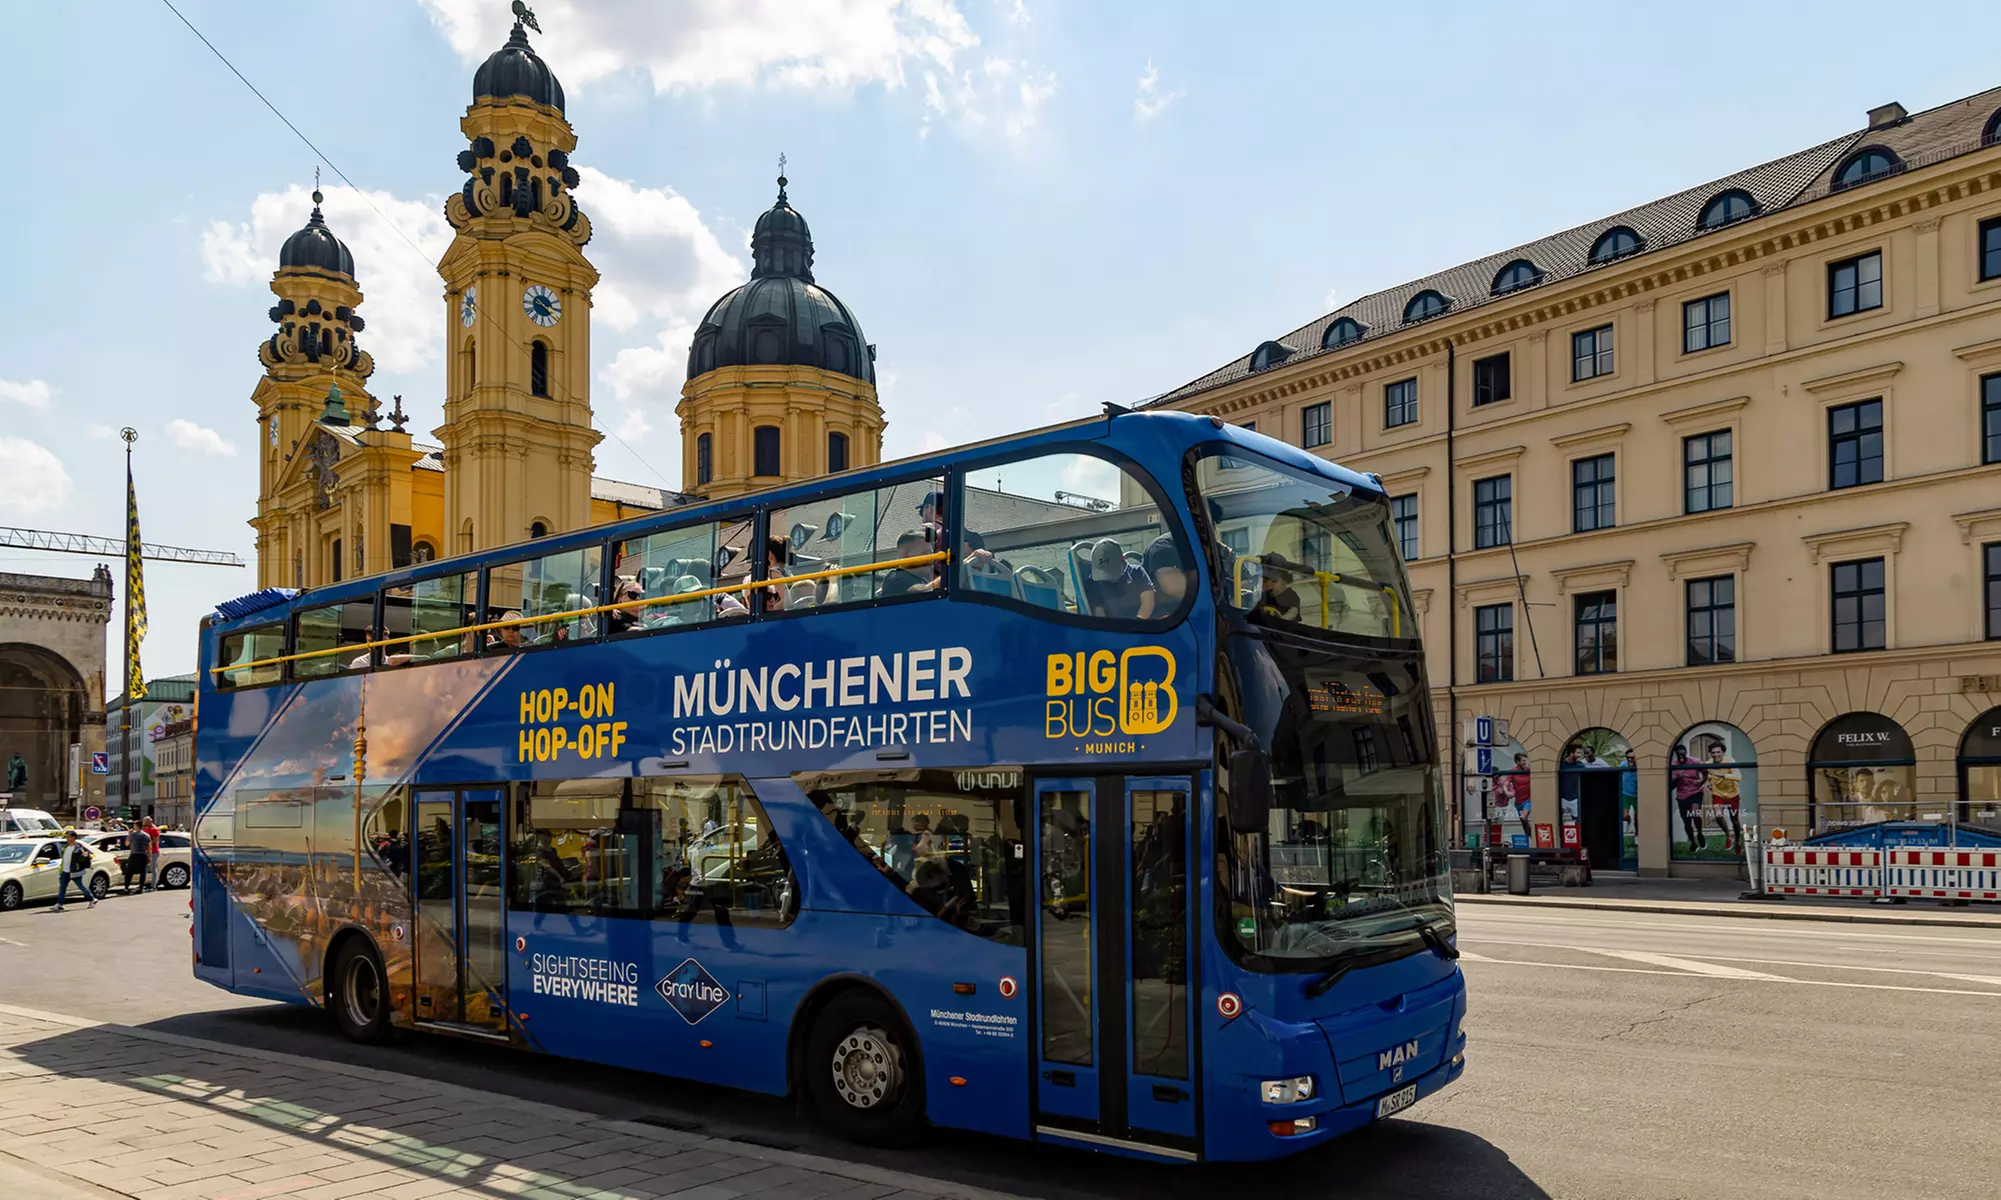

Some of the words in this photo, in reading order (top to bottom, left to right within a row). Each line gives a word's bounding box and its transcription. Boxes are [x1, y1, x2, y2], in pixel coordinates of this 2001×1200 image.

[673, 646, 973, 719] MÜNCHENER
[1047, 649, 1117, 697] BIG
[520, 681, 615, 724] HOP-ON
[1045, 697, 1116, 738] BUS
[518, 721, 628, 763] HOP-OFF
[672, 709, 972, 756] STADTRUNDFAHRTEN
[1479, 721, 1489, 740] U
[1838, 732, 1874, 743] FELIX
[1876, 732, 1890, 741] W.
[1085, 742, 1136, 754] MUNICH
[533, 953, 638, 984] SIGHTSEEING
[533, 974, 638, 1007] EVERYWHERE
[930, 1009, 964, 1021] Münchener
[1379, 1040, 1418, 1071] MAN
